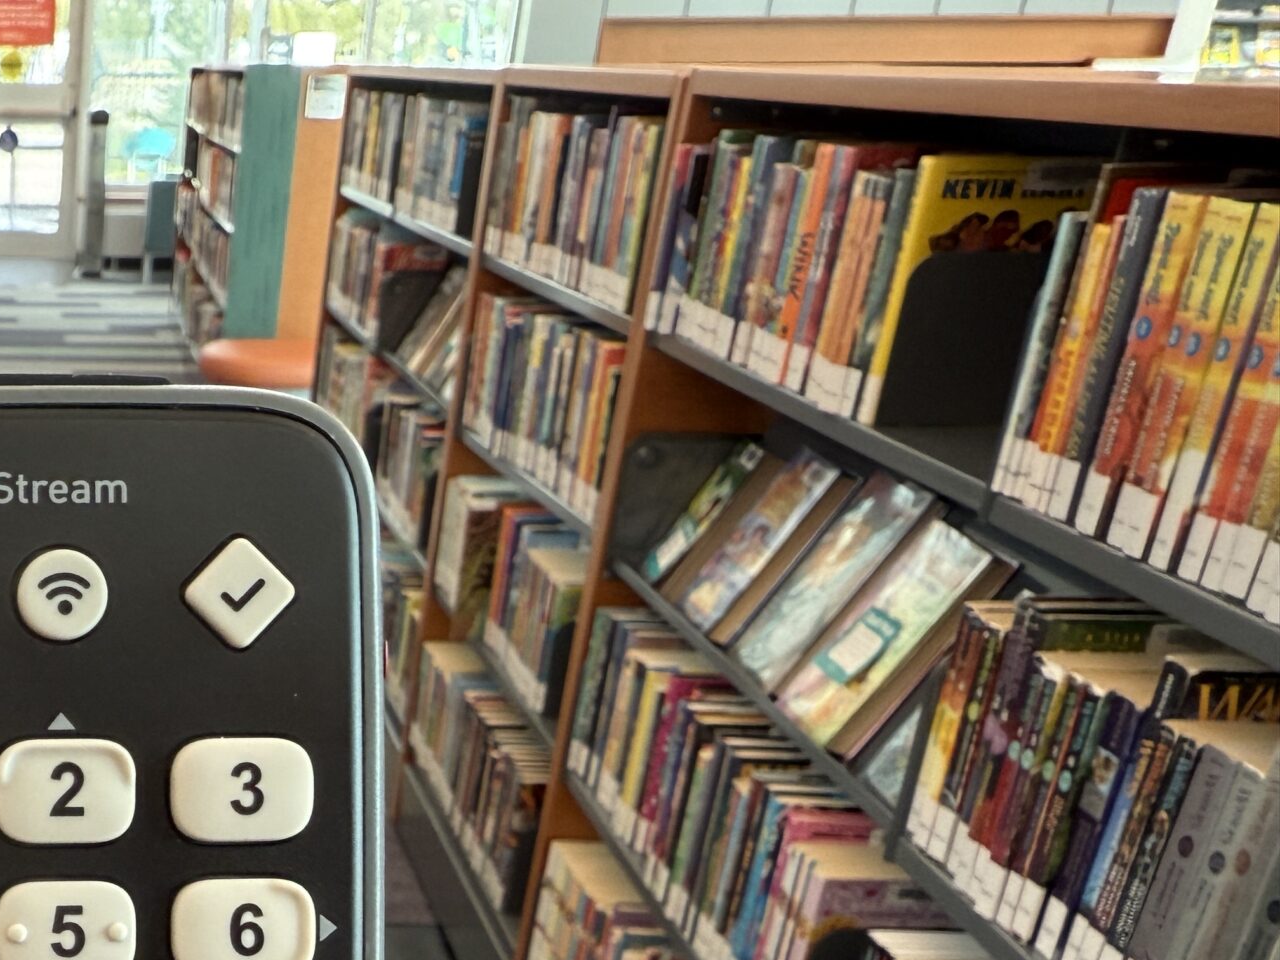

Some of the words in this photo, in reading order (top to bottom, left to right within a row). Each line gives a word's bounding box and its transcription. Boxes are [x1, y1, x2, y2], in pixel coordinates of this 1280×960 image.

[942, 178, 1016, 200] KEVIN
[49, 761, 85, 817] 2
[230, 761, 265, 816] 3
[50, 905, 86, 958] 5
[229, 902, 265, 957] 6
